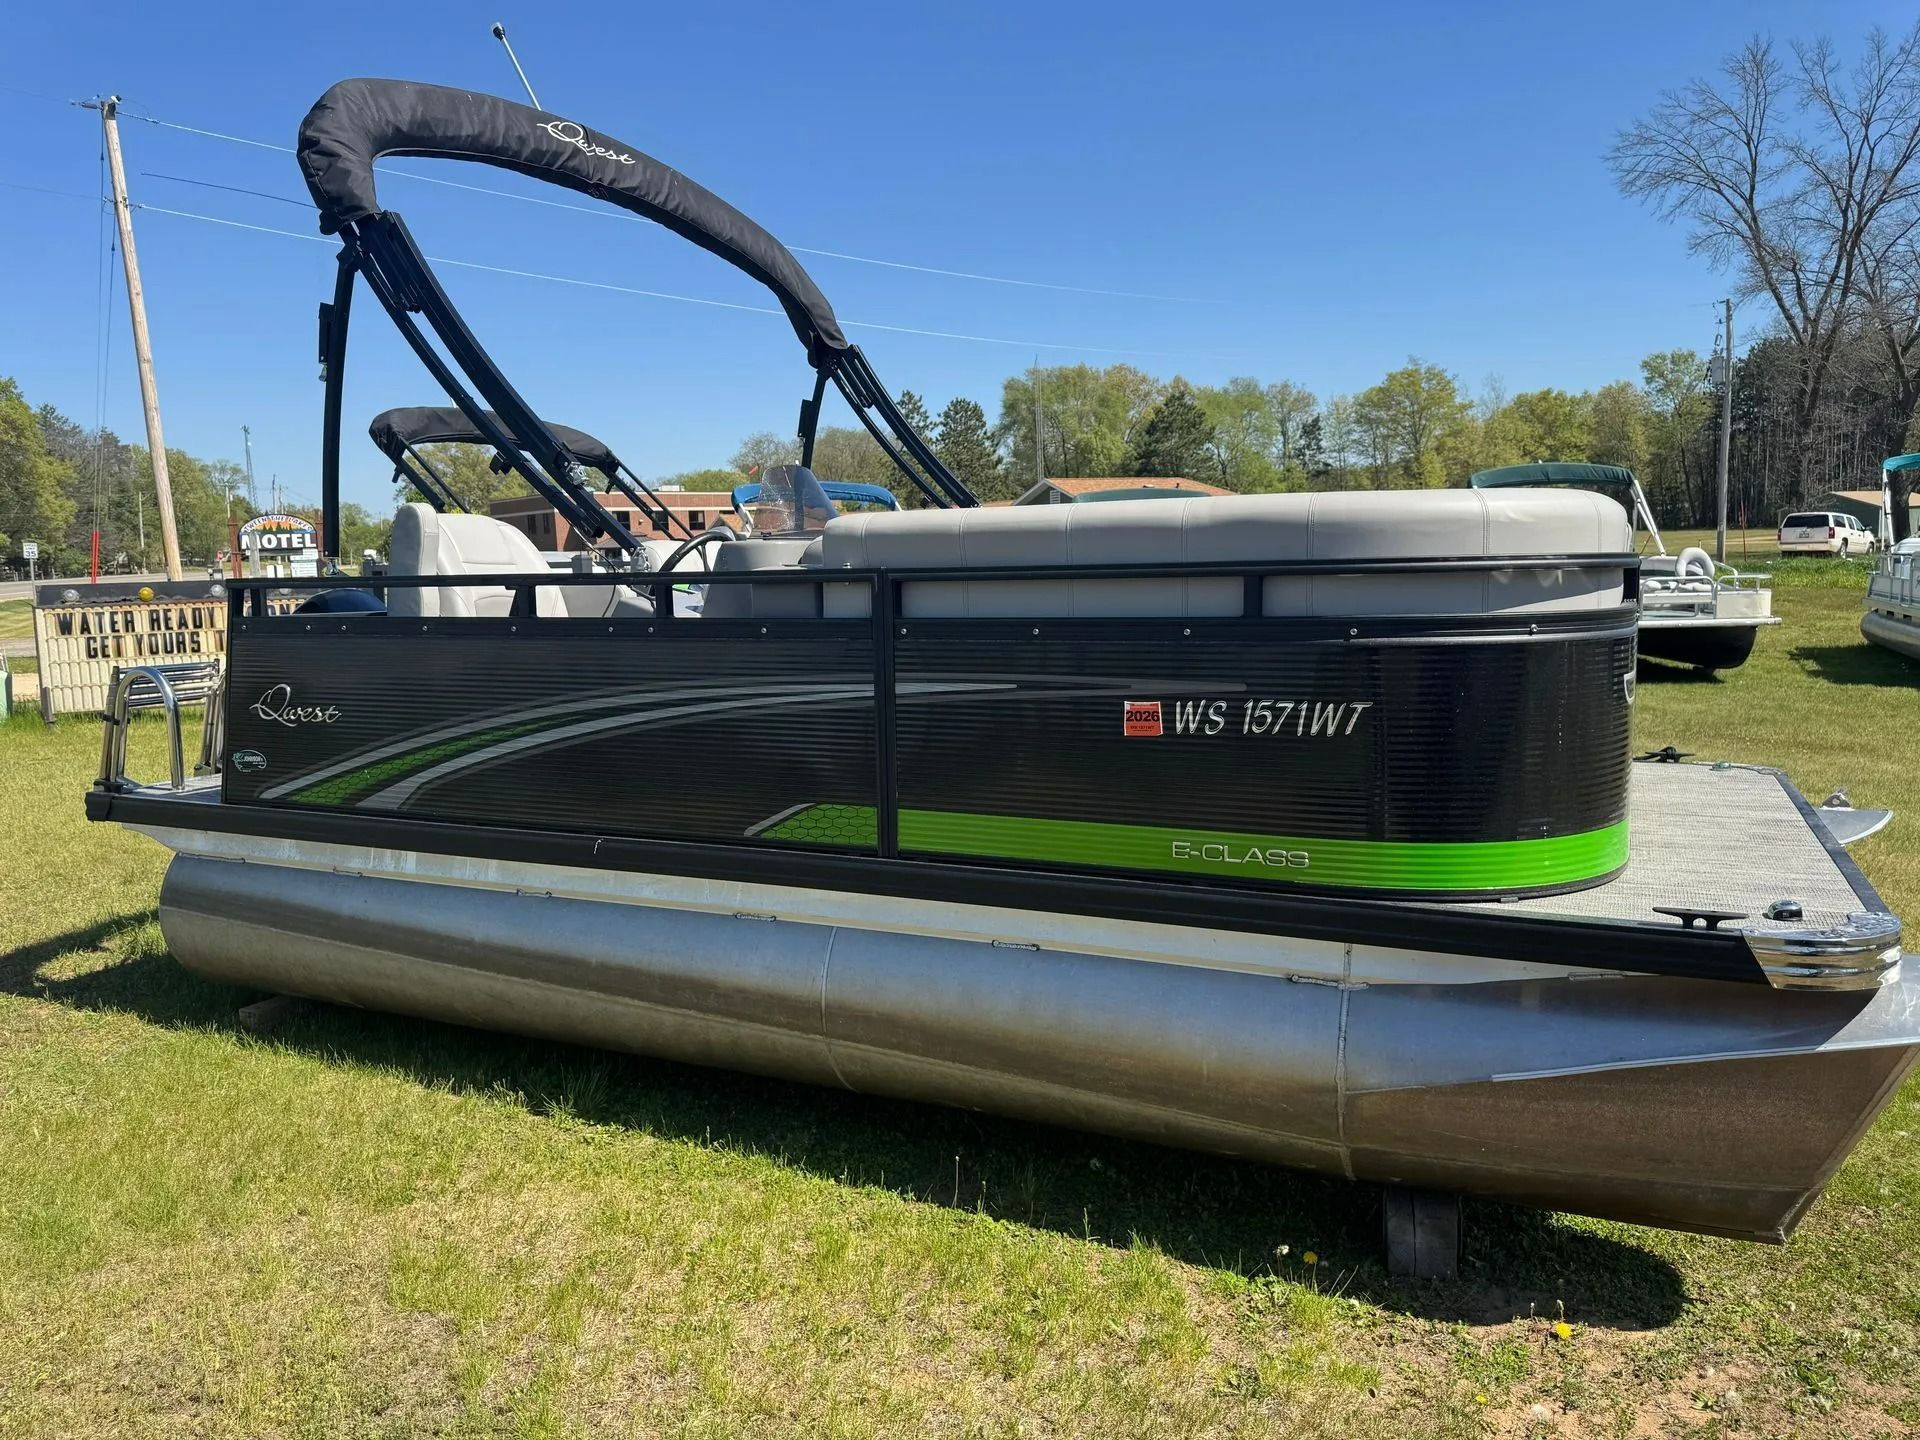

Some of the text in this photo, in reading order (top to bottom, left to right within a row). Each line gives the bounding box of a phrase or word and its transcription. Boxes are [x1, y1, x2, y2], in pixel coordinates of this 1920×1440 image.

[536, 121, 636, 164] Qwest
[241, 533, 317, 549] MOTEL
[57, 607, 215, 635] WATER READY
[86, 635, 123, 659] GET
[134, 631, 202, 656] YOURS
[249, 683, 342, 727] Qwest
[1125, 710, 1161, 722] 2026
[1175, 699, 1374, 738] WS 1571WT
[1172, 841, 1310, 868] E-CLASS
